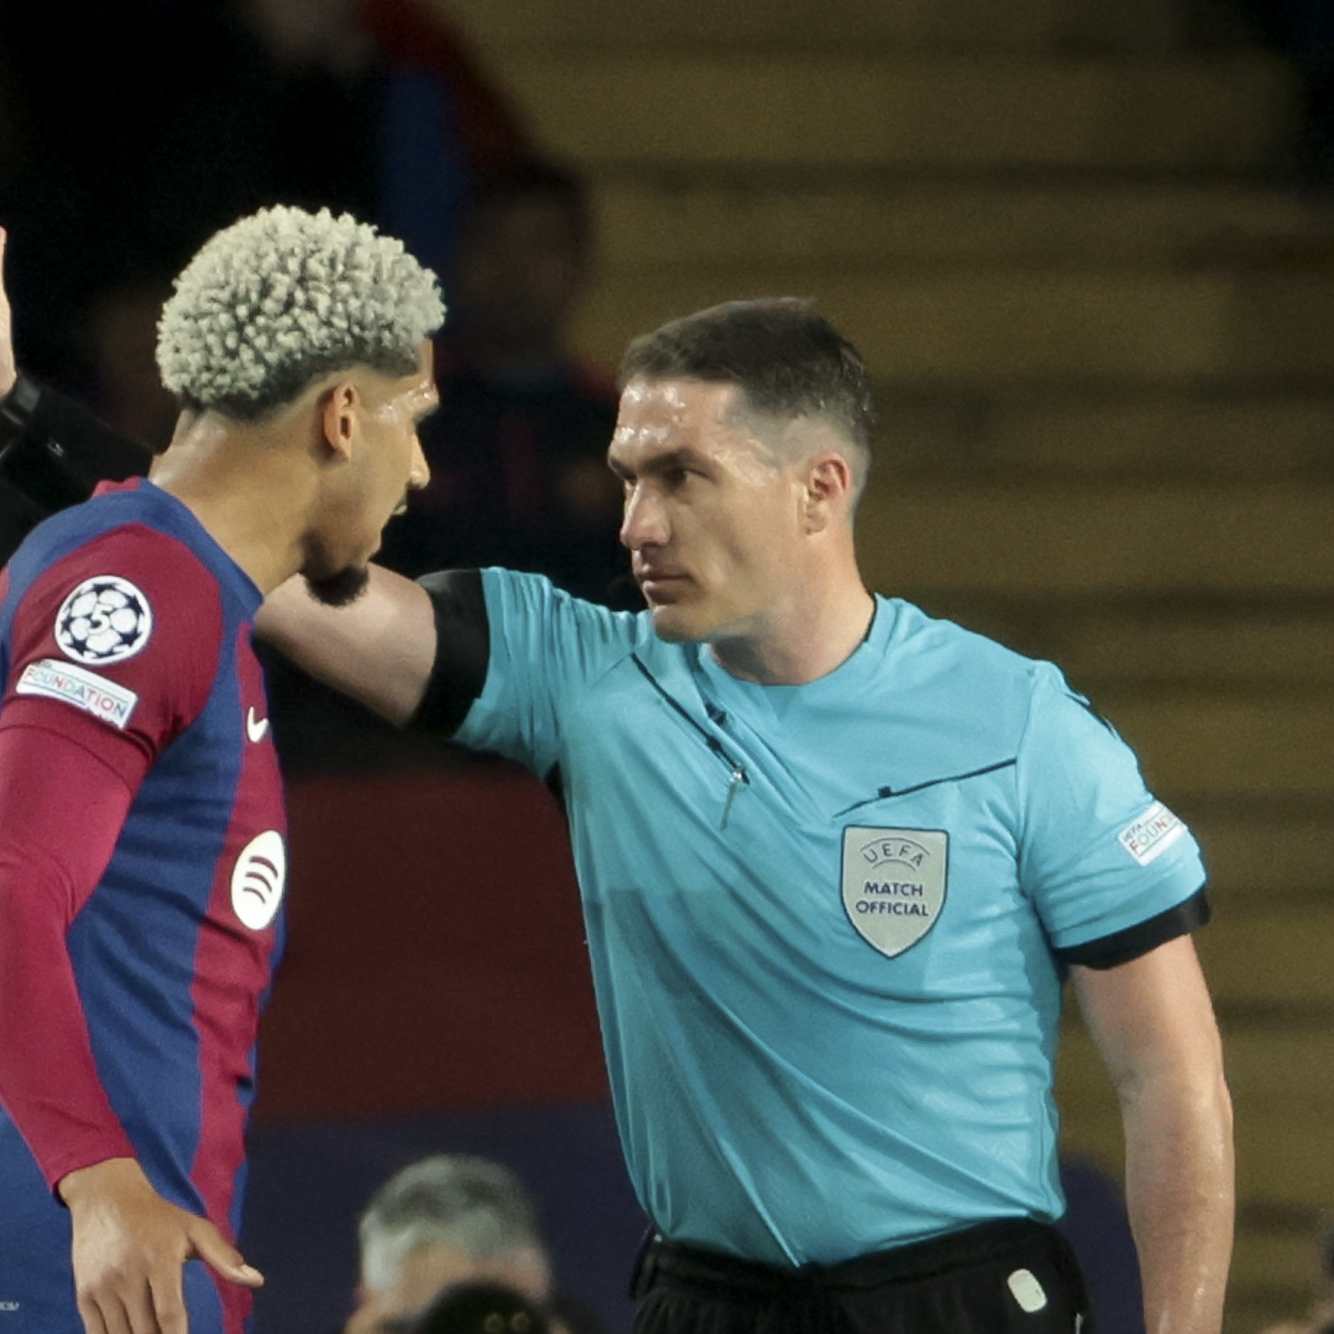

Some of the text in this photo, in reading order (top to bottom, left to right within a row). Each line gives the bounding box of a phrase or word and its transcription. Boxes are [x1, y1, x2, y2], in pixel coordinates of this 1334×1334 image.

[88, 604, 114, 635] 5
[24, 665, 128, 718] FOUNDATION
[863, 843, 924, 867] UEFA
[864, 881, 924, 897] MATCH
[855, 900, 930, 917] OFFICIAL
